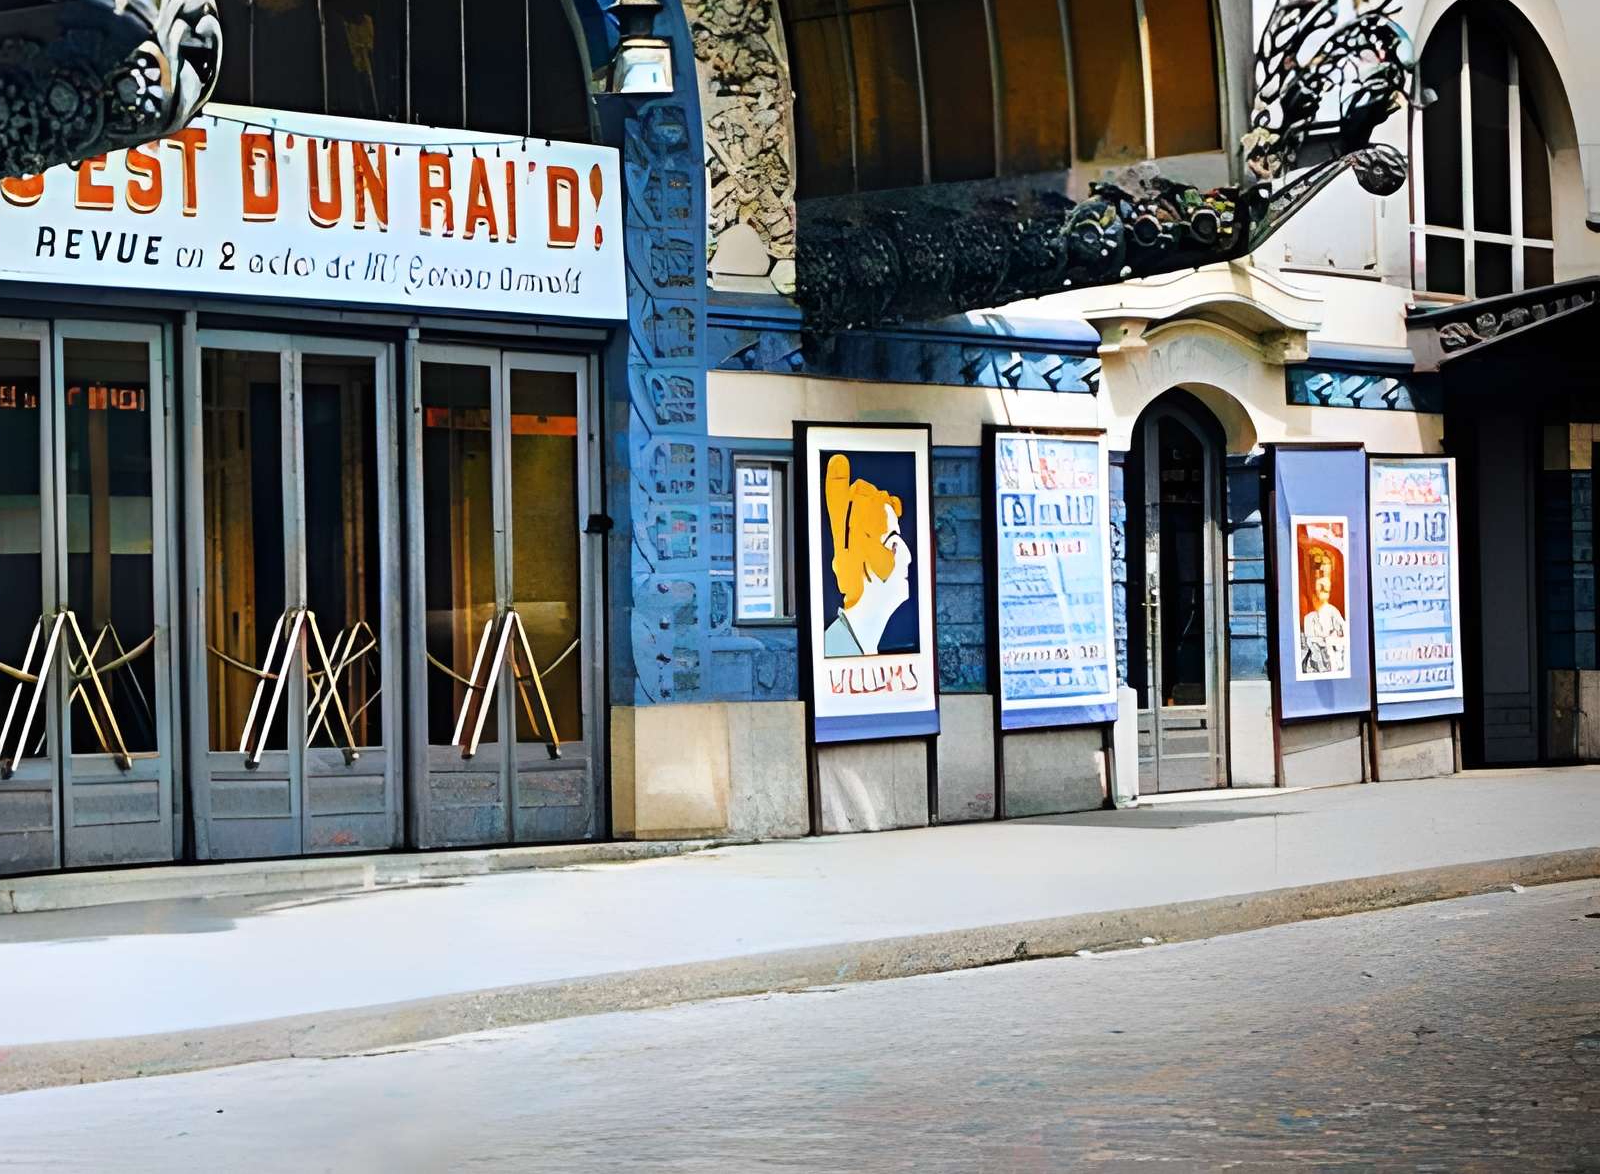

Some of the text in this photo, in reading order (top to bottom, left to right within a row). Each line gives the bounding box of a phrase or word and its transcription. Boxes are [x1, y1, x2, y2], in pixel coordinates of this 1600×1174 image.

[241, 132, 389, 233] D'UN
[35, 225, 163, 266] REVUE
[219, 241, 236, 271] 2
